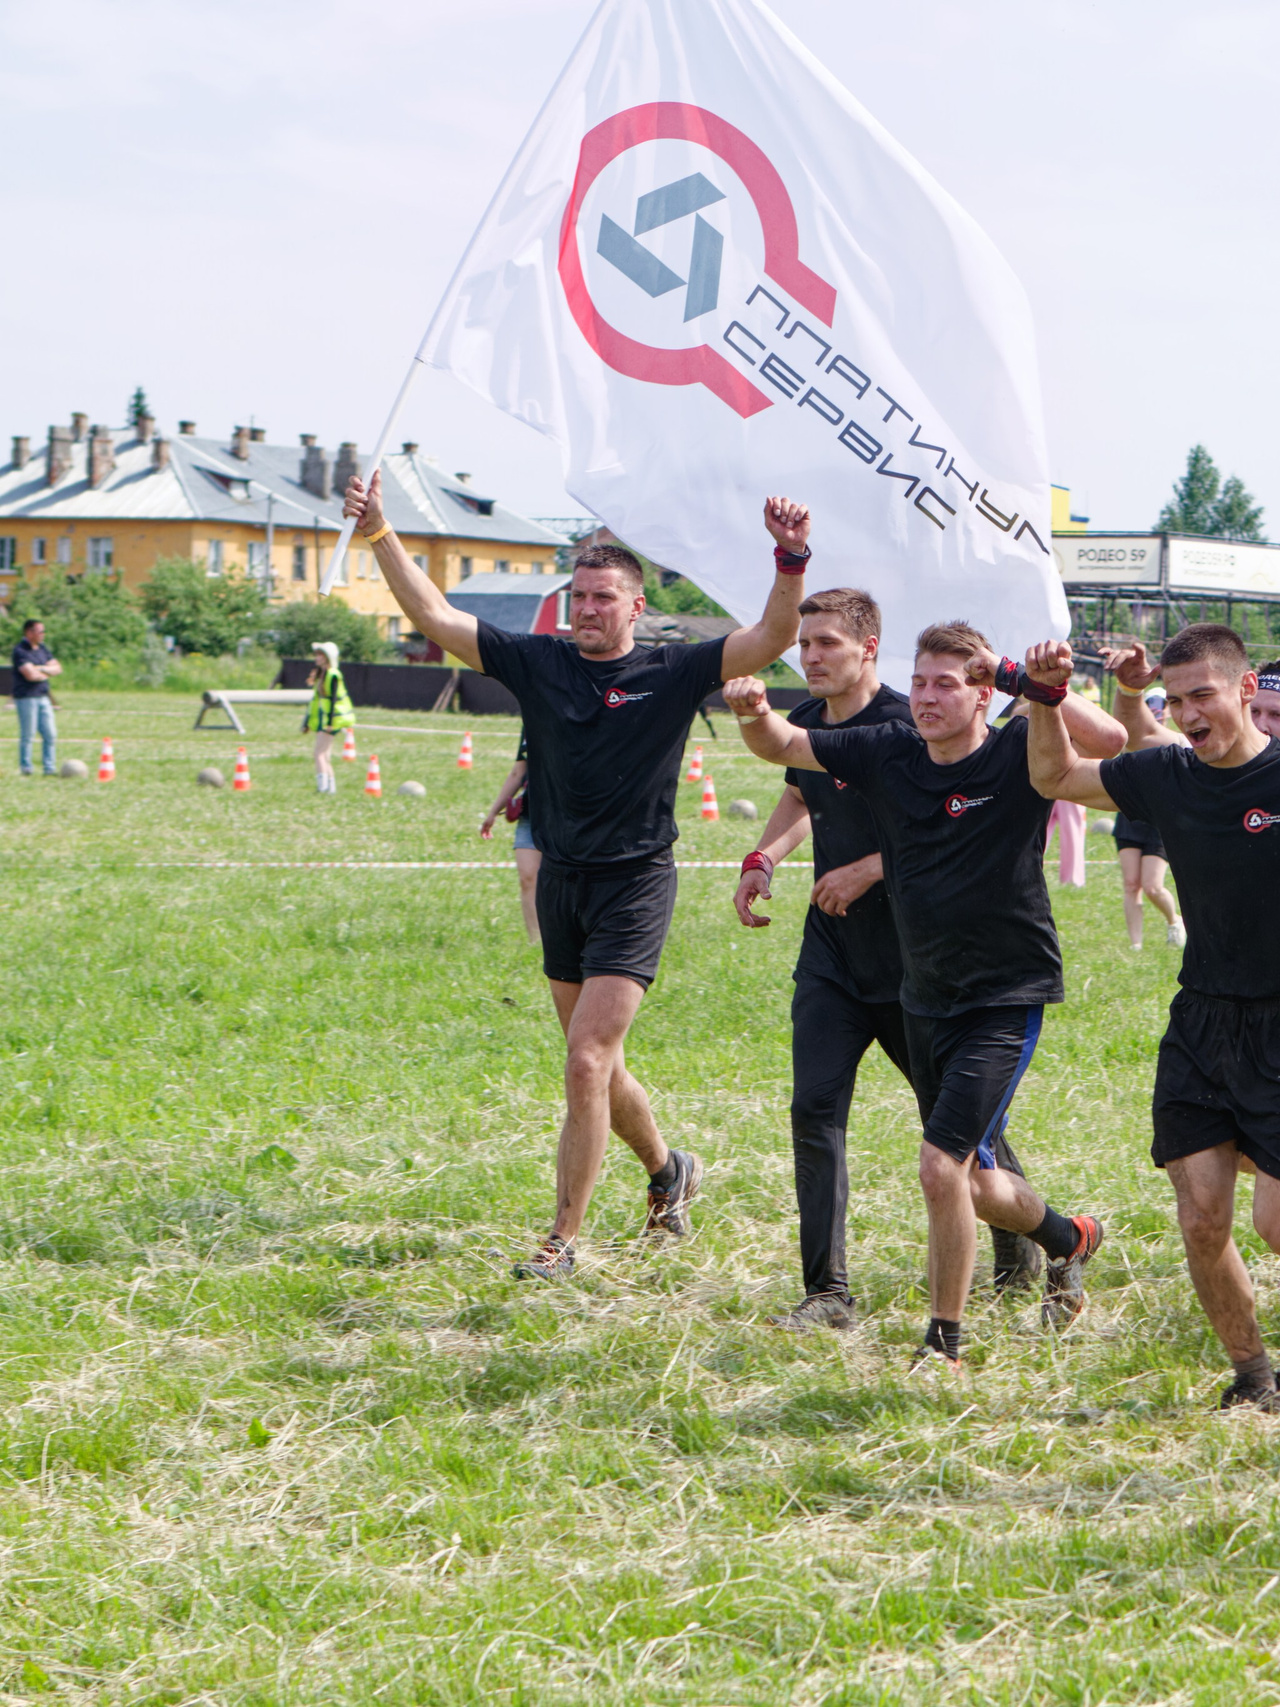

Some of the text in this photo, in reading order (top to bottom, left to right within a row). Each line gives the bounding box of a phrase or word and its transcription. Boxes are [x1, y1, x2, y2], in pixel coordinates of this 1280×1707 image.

[723, 320, 957, 530] СЕРВИС
[1078, 549, 1146, 563] РОДЕО 59
